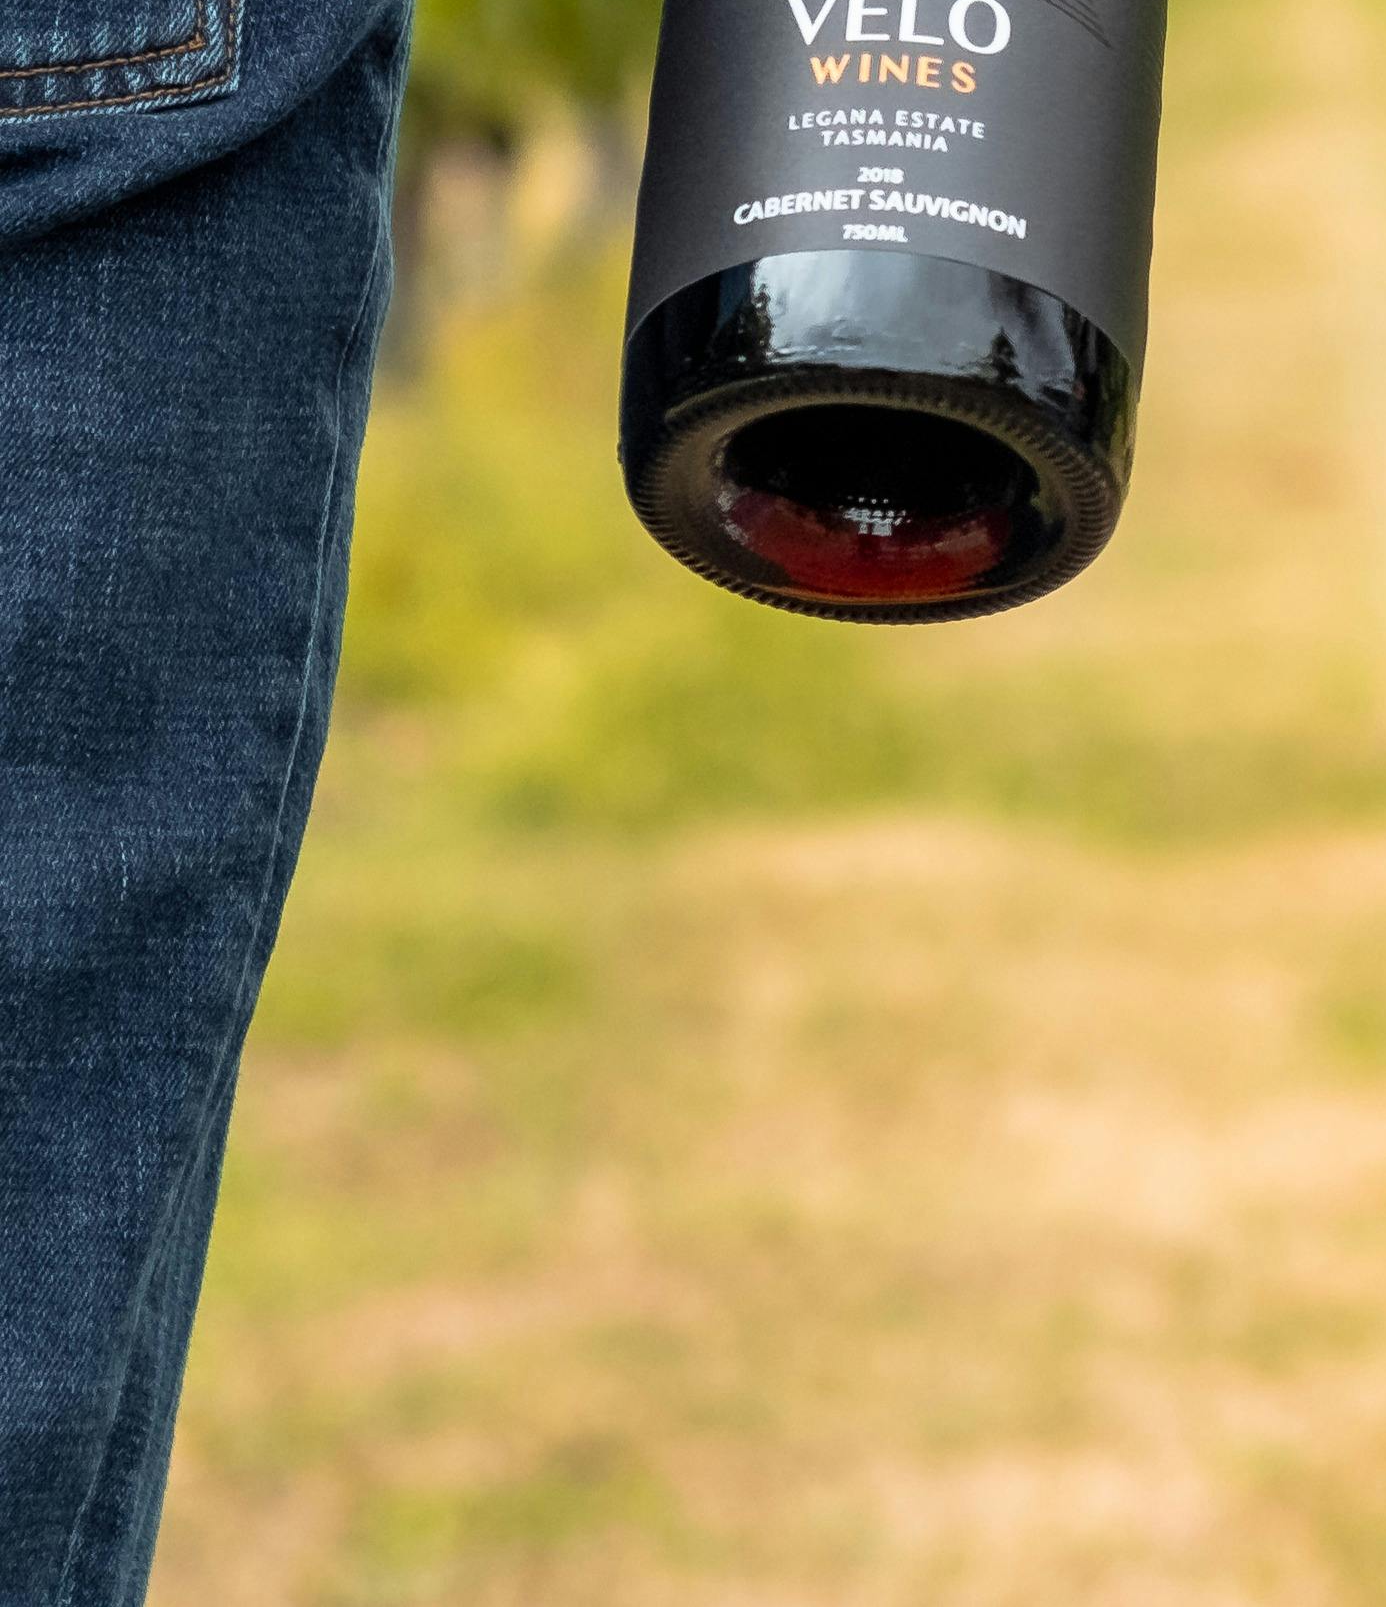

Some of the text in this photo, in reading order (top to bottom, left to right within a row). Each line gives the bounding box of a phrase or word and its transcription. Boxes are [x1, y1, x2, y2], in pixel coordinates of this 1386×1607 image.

[809, 53, 977, 94] WINES
[788, 108, 986, 140] LEGANA ESTATE
[821, 129, 949, 153] TASMANIA
[732, 189, 1027, 239] CABERNET SAUVIGNON
[841, 223, 909, 243] 750ML
